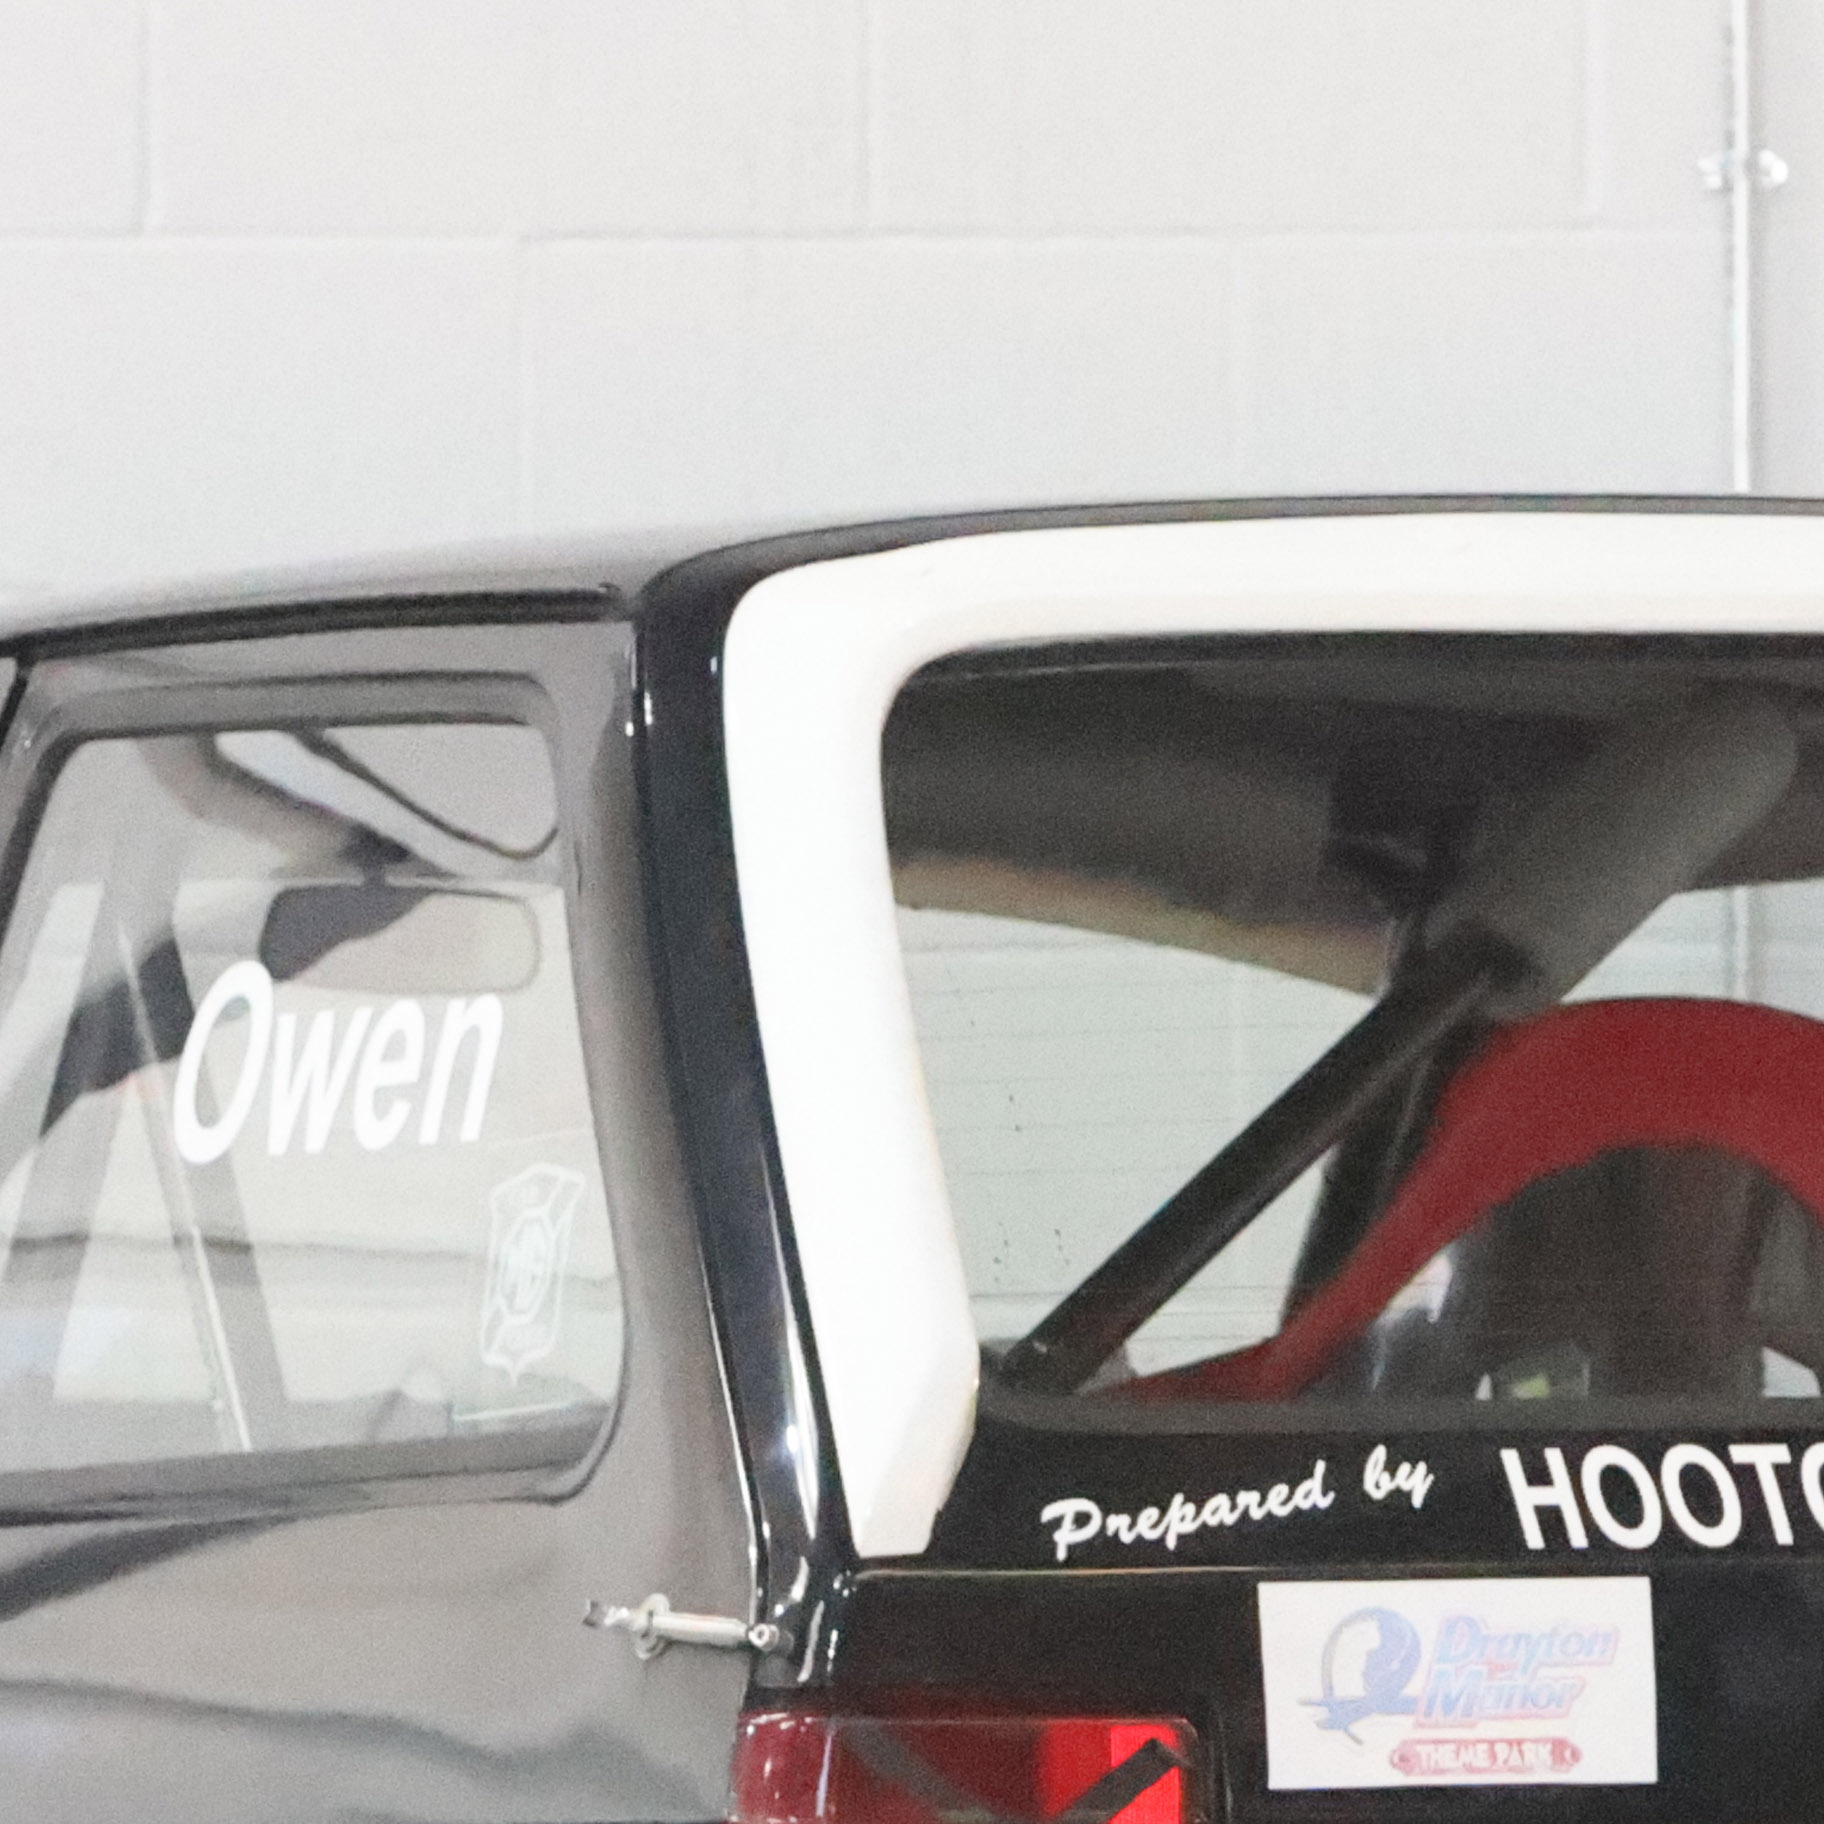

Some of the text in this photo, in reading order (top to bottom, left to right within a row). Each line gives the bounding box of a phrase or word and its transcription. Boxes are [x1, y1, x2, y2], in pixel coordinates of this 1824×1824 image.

[174, 960, 503, 1164] Owen
[1041, 1459, 1335, 1562] Prepared
[1363, 1443, 1435, 1509] by
[1495, 1741, 1554, 1771] PARK
